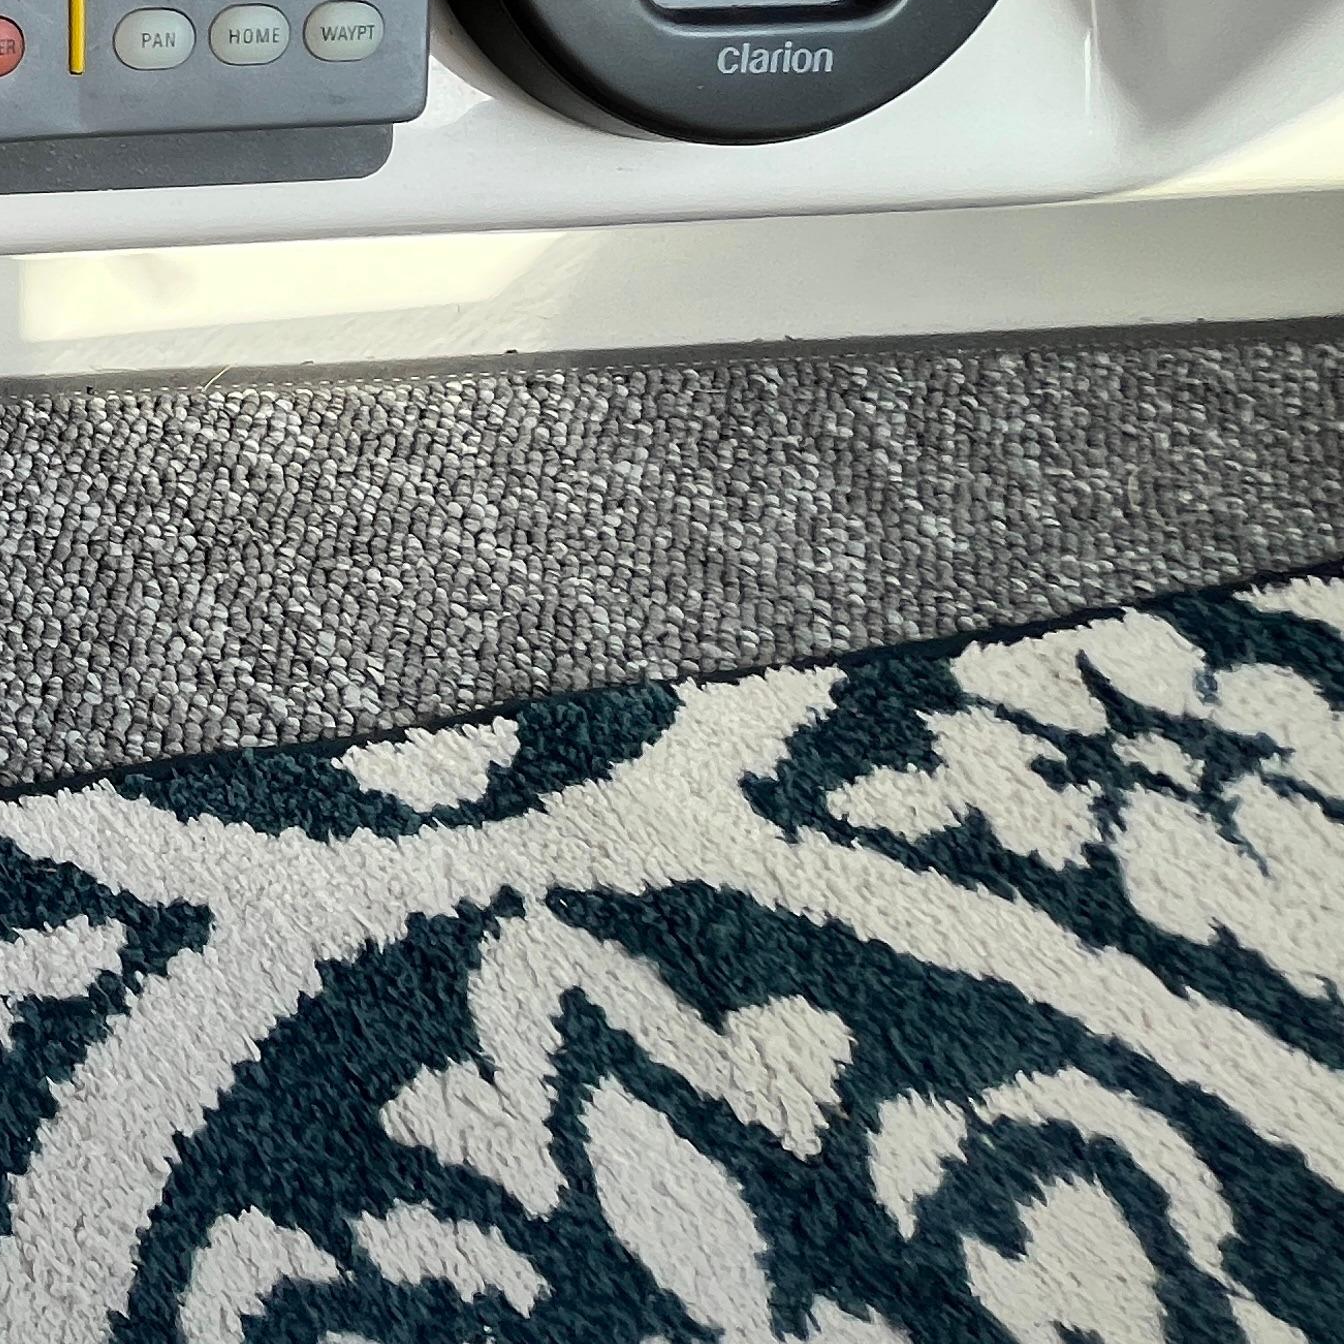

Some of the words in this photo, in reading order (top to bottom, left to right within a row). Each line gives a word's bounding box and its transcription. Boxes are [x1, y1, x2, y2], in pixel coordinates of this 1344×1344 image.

[141, 32, 176, 48] PAN
[228, 27, 281, 45] HOME
[320, 24, 376, 42] WAYPT
